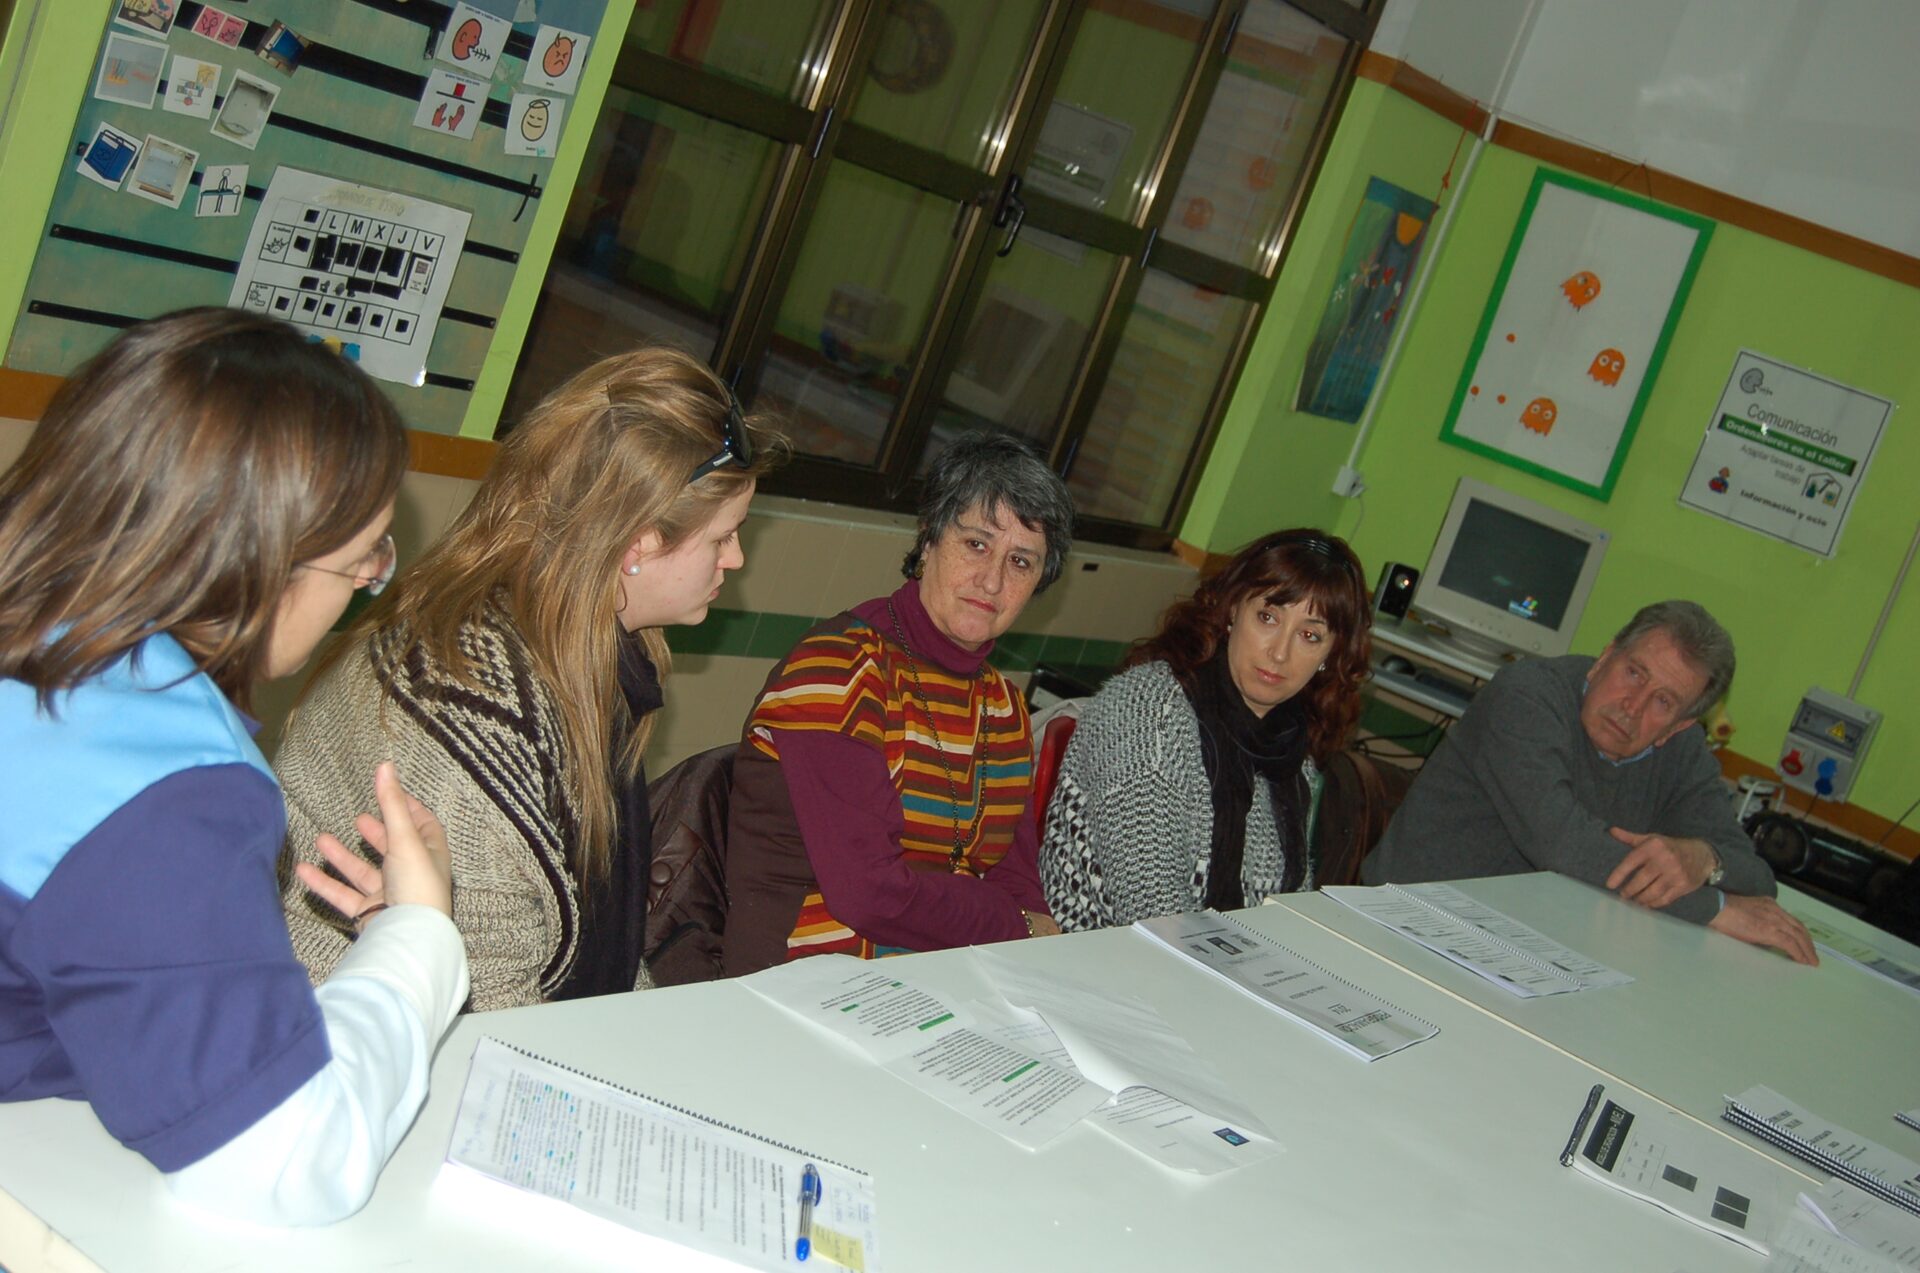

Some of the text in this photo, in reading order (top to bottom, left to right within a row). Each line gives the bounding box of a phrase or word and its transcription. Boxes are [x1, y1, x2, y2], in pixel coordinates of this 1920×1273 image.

[328, 214, 435, 250] L M X J V
[1747, 403, 1838, 447] Comunicación
[1791, 444, 1804, 456] en
[1805, 446, 1816, 460] el
[1818, 451, 1848, 471] taller
[1740, 488, 1798, 516] Información
